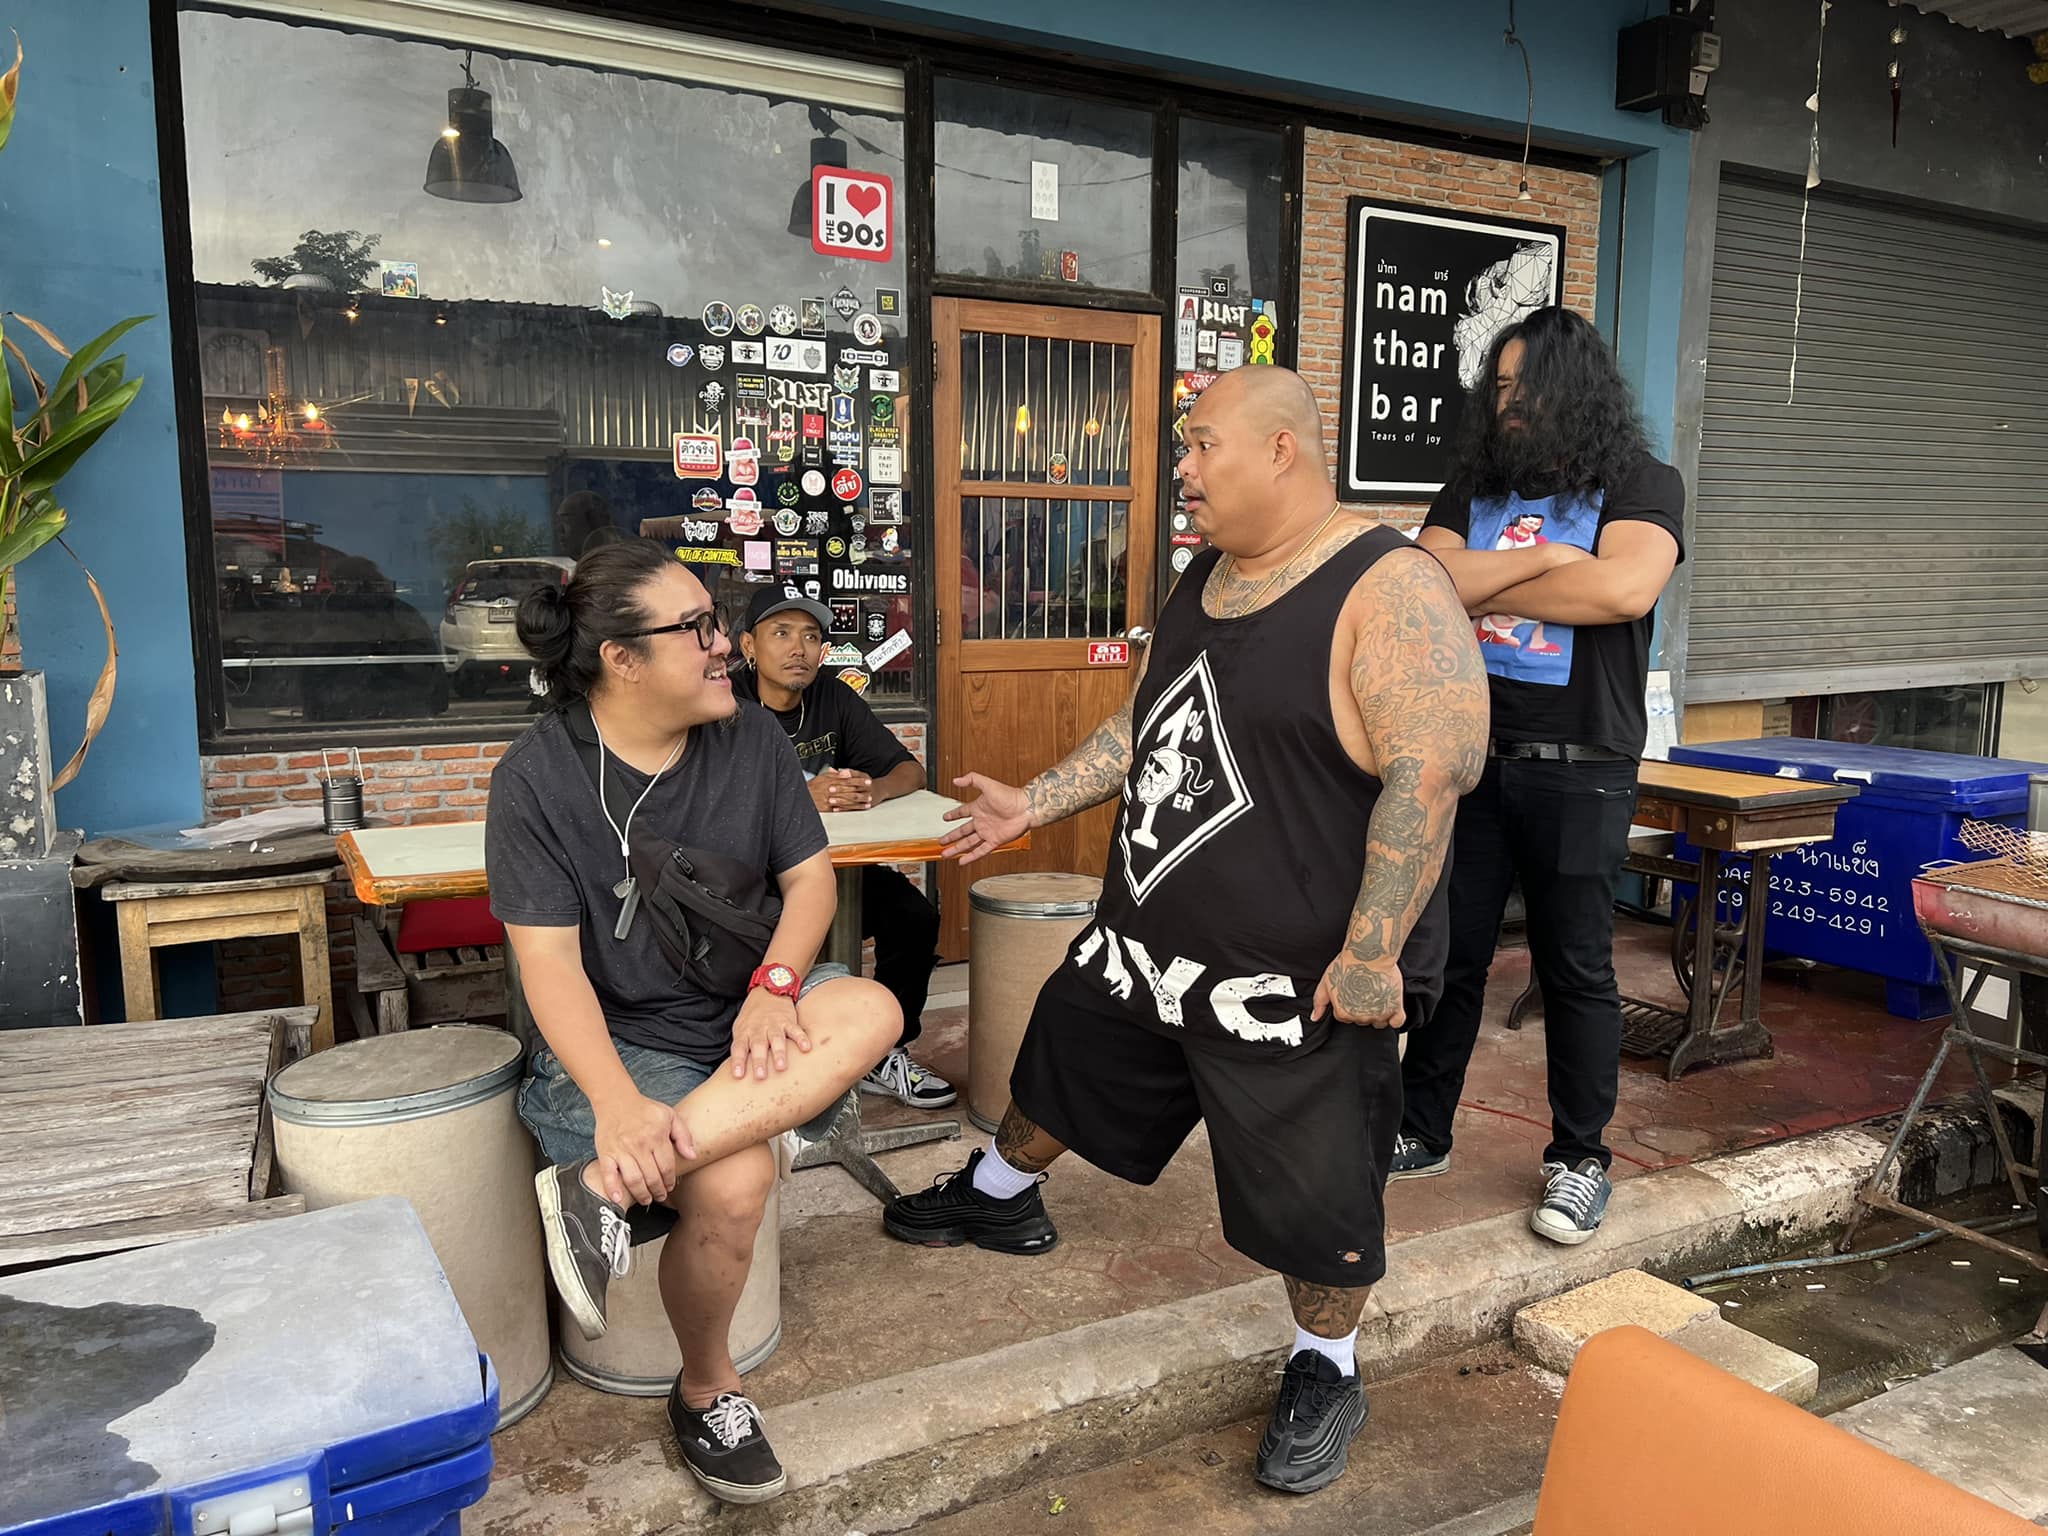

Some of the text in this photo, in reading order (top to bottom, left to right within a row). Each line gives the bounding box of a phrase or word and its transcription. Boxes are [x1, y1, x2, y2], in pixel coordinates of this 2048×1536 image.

[825, 182, 835, 215] I
[826, 219, 884, 248] THE 90s
[1376, 281, 1448, 316] nam
[1201, 299, 1250, 328] BLAST
[772, 343, 792, 361] 10
[1373, 329, 1446, 369] thar
[768, 377, 831, 409] BLAST
[1371, 383, 1443, 423] bar
[830, 431, 860, 442] BGPU
[1372, 430, 1442, 445] Tears of joy
[677, 549, 691, 560] OUT
[691, 550, 702, 560] OF
[703, 550, 738, 563] CONTROL
[833, 568, 907, 590] Oblivious
[1094, 653, 1122, 662] PULL
[1172, 792, 1195, 813] ER
[1772, 901, 1885, 937] 249-4291
